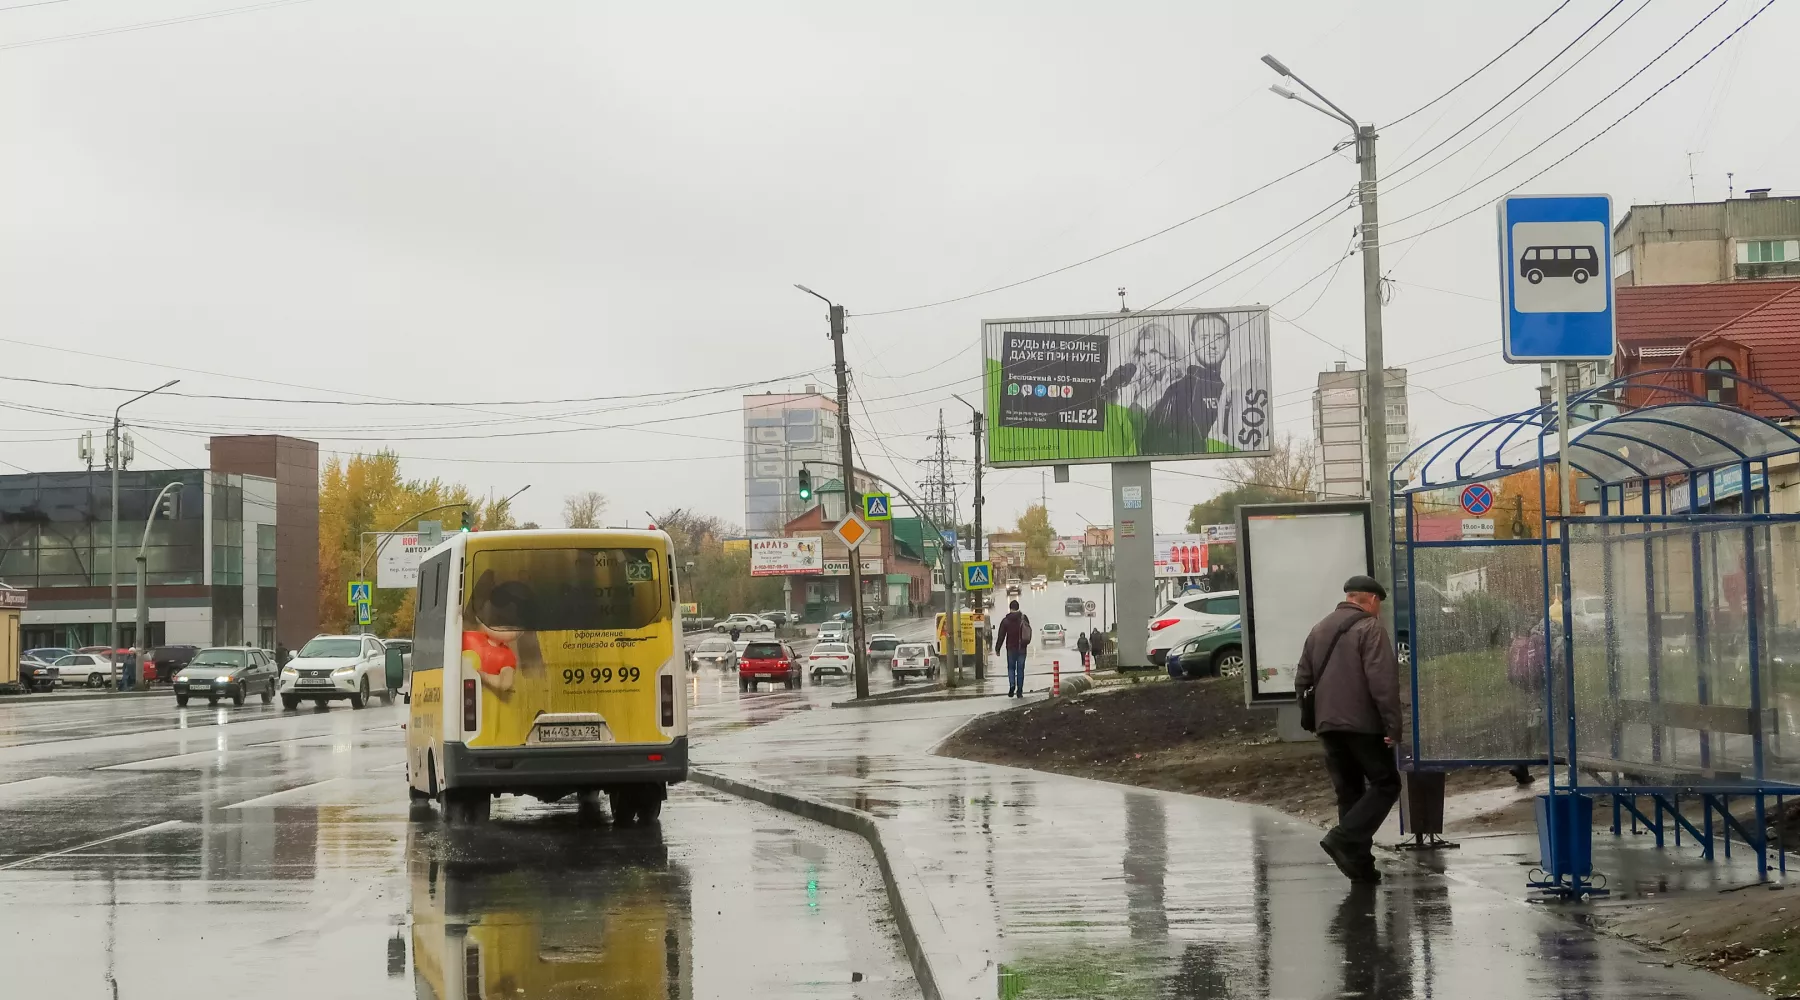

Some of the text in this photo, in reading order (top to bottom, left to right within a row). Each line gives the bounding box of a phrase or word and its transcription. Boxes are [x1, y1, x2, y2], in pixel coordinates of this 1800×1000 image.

[1010, 338, 1098, 352] БУДЬ НА ВОЛНЕ
[1009, 350, 1101, 364] ДАЖЕ ПРИ НУЛЕ
[1058, 408, 1098, 424] TELE2
[1237, 388, 1268, 447] SOS
[823, 562, 870, 570] КОМПКС
[574, 630, 623, 640] оформление
[562, 641, 576, 650] без
[576, 640, 609, 650] приезда
[562, 666, 641, 684] 99 99 99
